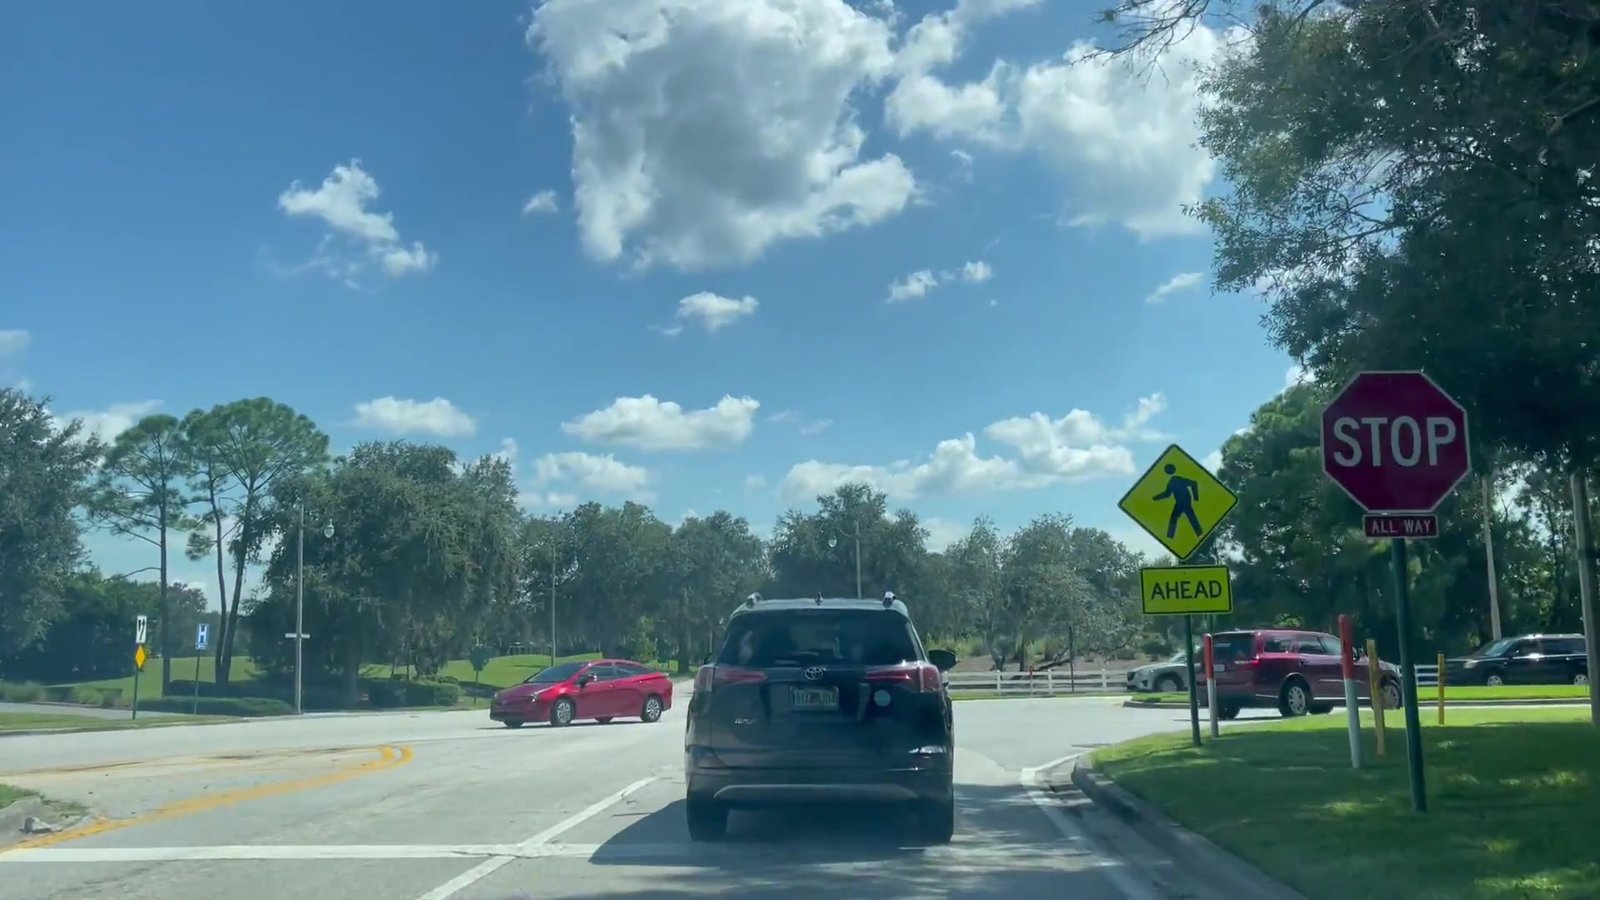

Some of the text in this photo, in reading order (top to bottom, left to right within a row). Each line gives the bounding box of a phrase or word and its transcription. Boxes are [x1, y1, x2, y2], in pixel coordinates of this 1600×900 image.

[1333, 415, 1456, 467] STOP
[1371, 519, 1431, 534] ALL WAY
[1151, 580, 1222, 600] AHEAD
[198, 625, 208, 643] H
